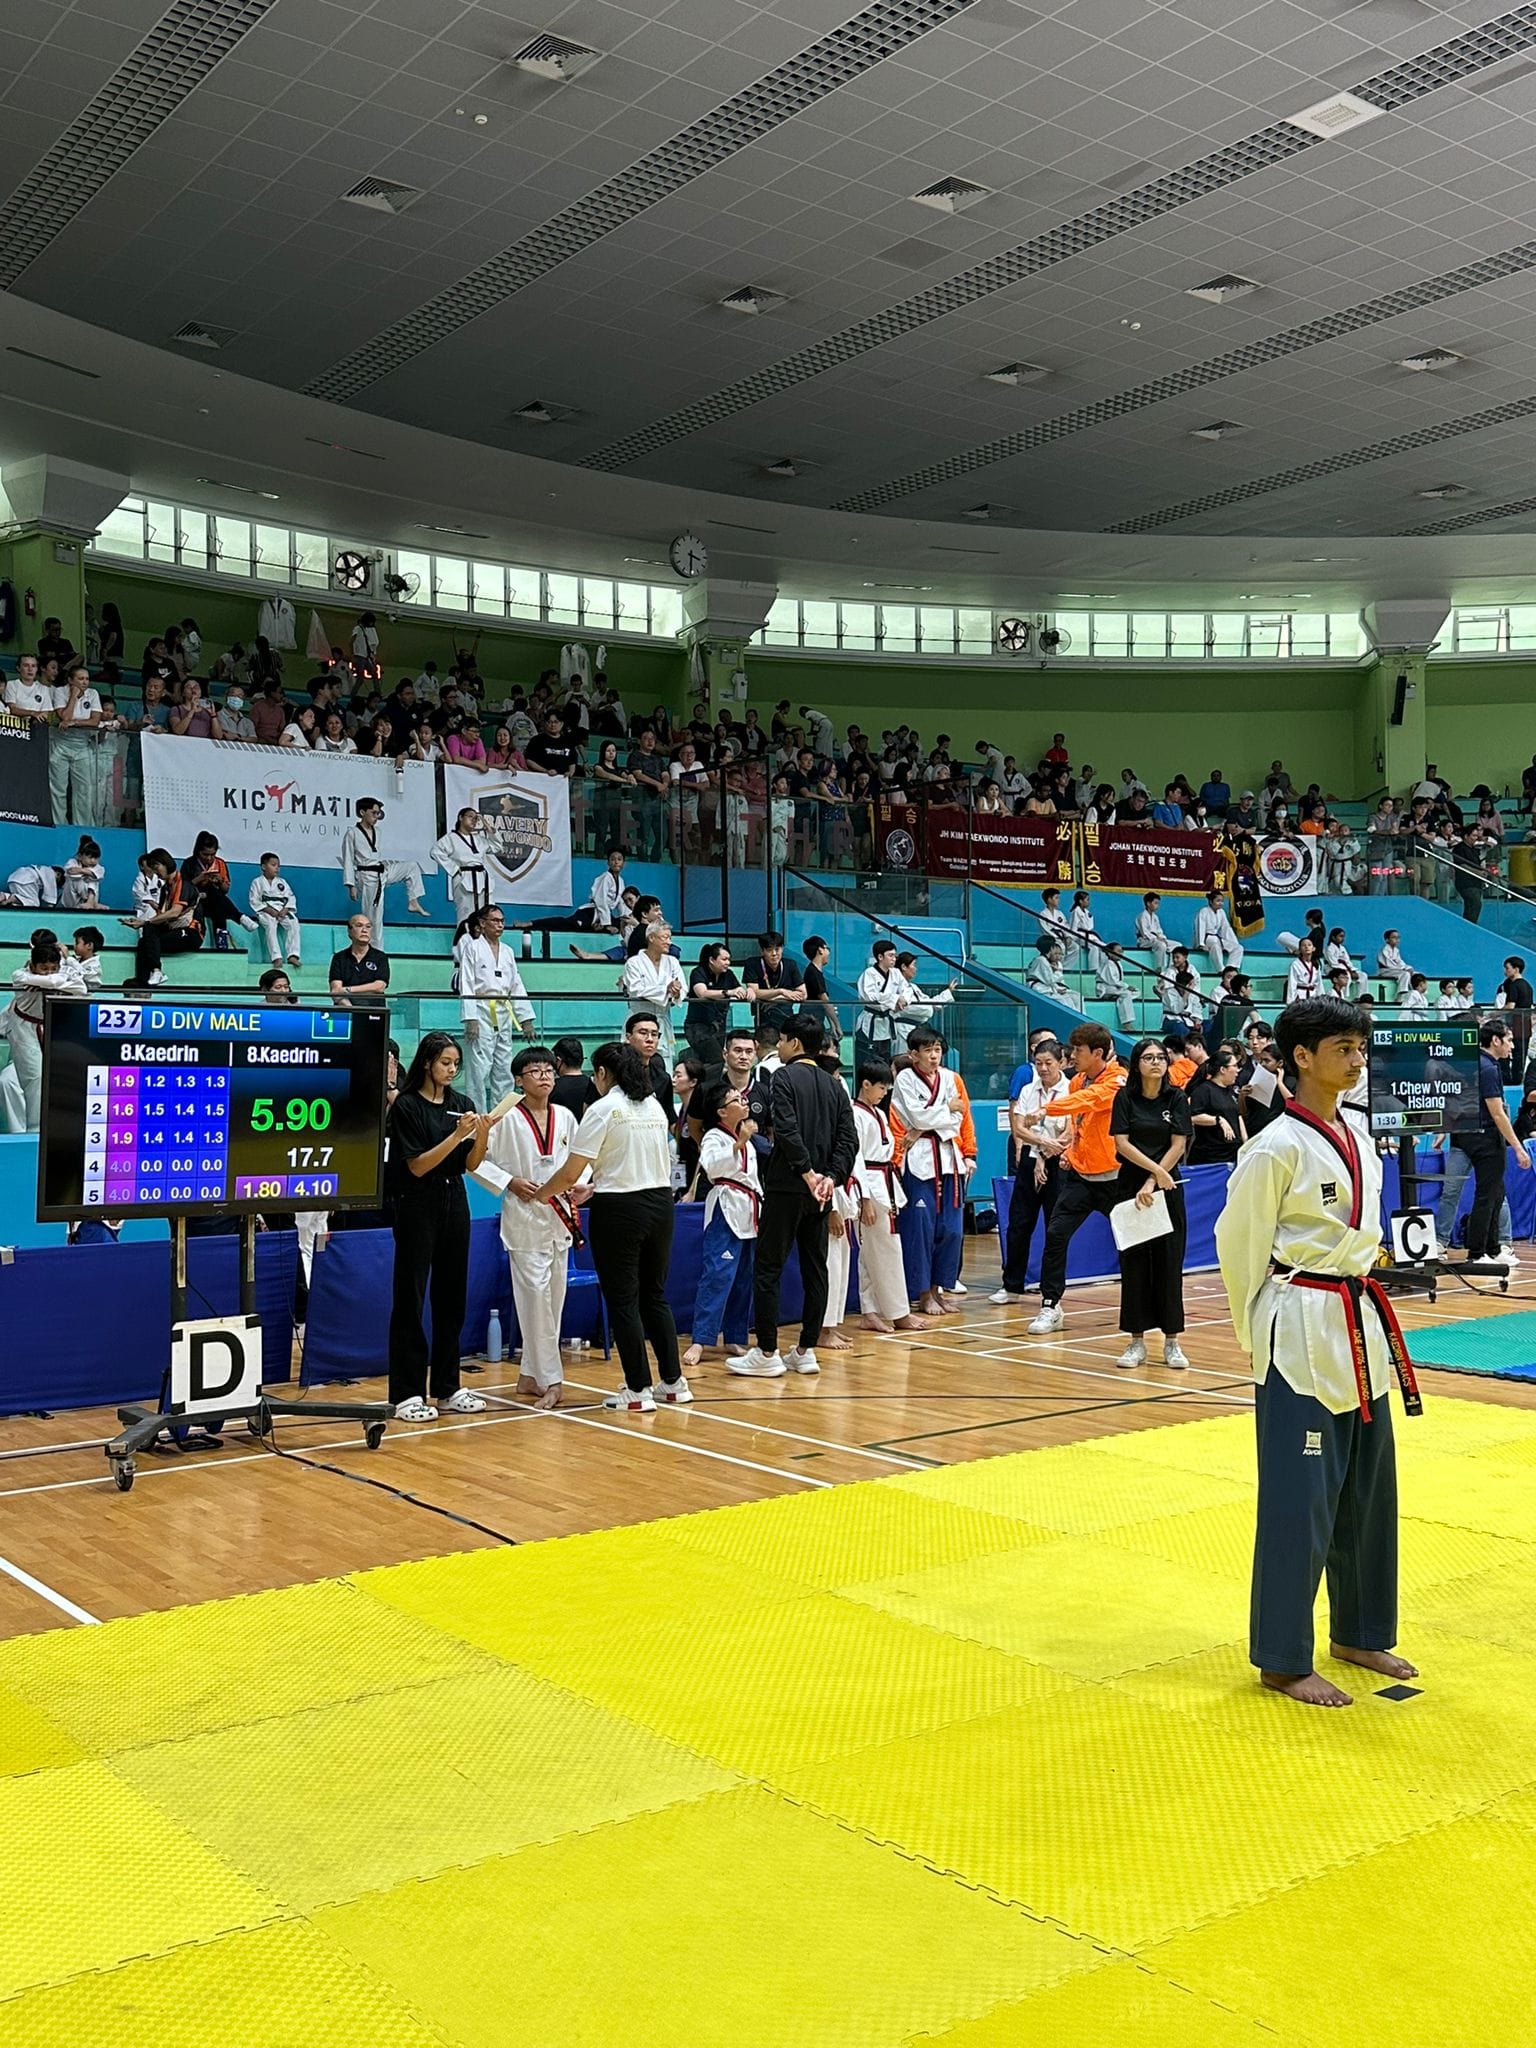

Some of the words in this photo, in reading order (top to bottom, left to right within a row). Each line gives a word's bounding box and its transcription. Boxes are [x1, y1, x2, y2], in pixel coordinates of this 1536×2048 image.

[0, 714, 31, 731] TITUTE
[223, 787, 386, 820] KICMATI
[242, 818, 352, 837] TAEKWON
[940, 830, 949, 839] JH
[950, 832, 964, 840] KIM
[965, 833, 1009, 844] TAEKWONDO
[1009, 837, 1045, 846] INSTITUTE
[1109, 843, 1131, 851] JOHAN
[1131, 844, 1171, 854] TAEKWONDO
[1171, 847, 1203, 857] INSTITUTE
[98, 1009, 141, 1029] 237
[151, 1011, 166, 1029] D
[171, 1011, 203, 1030] DIV
[209, 1013, 261, 1032] MALE
[326, 1018, 334, 1033] 1
[1374, 1032, 1392, 1042] 185
[1395, 1034, 1402, 1042] H
[1403, 1033, 1418, 1043] DIV
[1419, 1033, 1441, 1043] MALE
[1467, 1033, 1472, 1042] 1
[120, 1044, 199, 1064] 8.Kaedrin
[247, 1046, 319, 1064] 8.Kaedrin
[1428, 1045, 1454, 1057] 1.Che
[93, 1074, 101, 1087] 1
[113, 1075, 135, 1088] 1.9
[144, 1075, 166, 1088] 1.2
[175, 1075, 196, 1088] 1.3
[205, 1075, 226, 1088] 1.3
[1391, 1081, 1431, 1096] 1.Chew
[1434, 1081, 1462, 1098] Yong
[91, 1103, 102, 1115] 2
[112, 1103, 134, 1117] 1.6
[143, 1103, 165, 1116] 1.5
[174, 1103, 195, 1116] 1.4
[204, 1103, 225, 1116] 1.5
[1408, 1096, 1446, 1109] Hsiang
[250, 1098, 331, 1132] 5.90
[1377, 1116, 1397, 1126] 1:30
[90, 1132, 101, 1144] 3
[111, 1131, 133, 1145] 1.9
[143, 1131, 164, 1144] 1.4
[173, 1131, 194, 1144] 1.4
[203, 1131, 224, 1144] 1.3
[89, 1160, 99, 1173] 4
[110, 1160, 132, 1173] 4.0
[141, 1160, 163, 1172] 0.0
[171, 1159, 193, 1172] 0.0
[201, 1159, 223, 1171] 0.0
[287, 1147, 334, 1168] 17.7
[88, 1190, 99, 1203] 5
[108, 1188, 131, 1201] 4.0
[140, 1187, 161, 1200] 0.0
[170, 1186, 192, 1199] 0.0
[200, 1186, 221, 1199] 0.0
[243, 1181, 282, 1199] 1.80
[294, 1179, 332, 1197] 4.10
[1401, 1215, 1429, 1261] C
[190, 1330, 245, 1402] D
